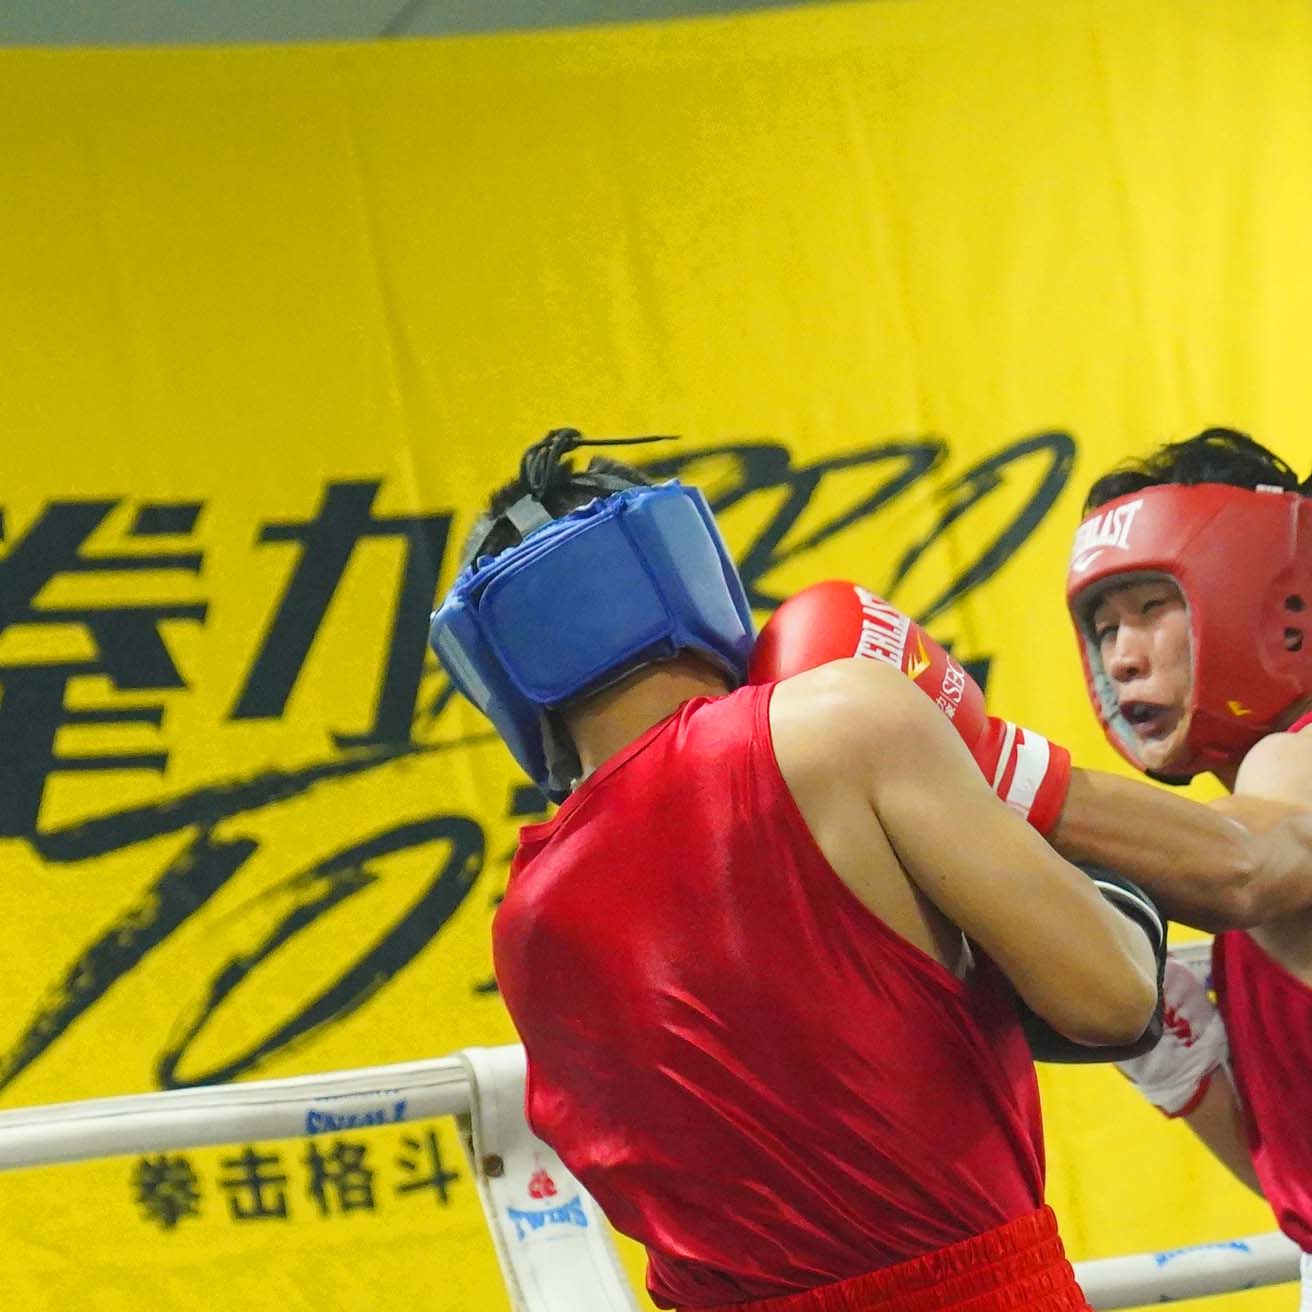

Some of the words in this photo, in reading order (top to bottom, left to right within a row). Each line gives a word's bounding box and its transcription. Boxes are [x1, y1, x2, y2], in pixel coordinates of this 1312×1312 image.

[131, 1130, 460, 1234] 拳击格斗
[507, 1195, 588, 1242] TWINS
